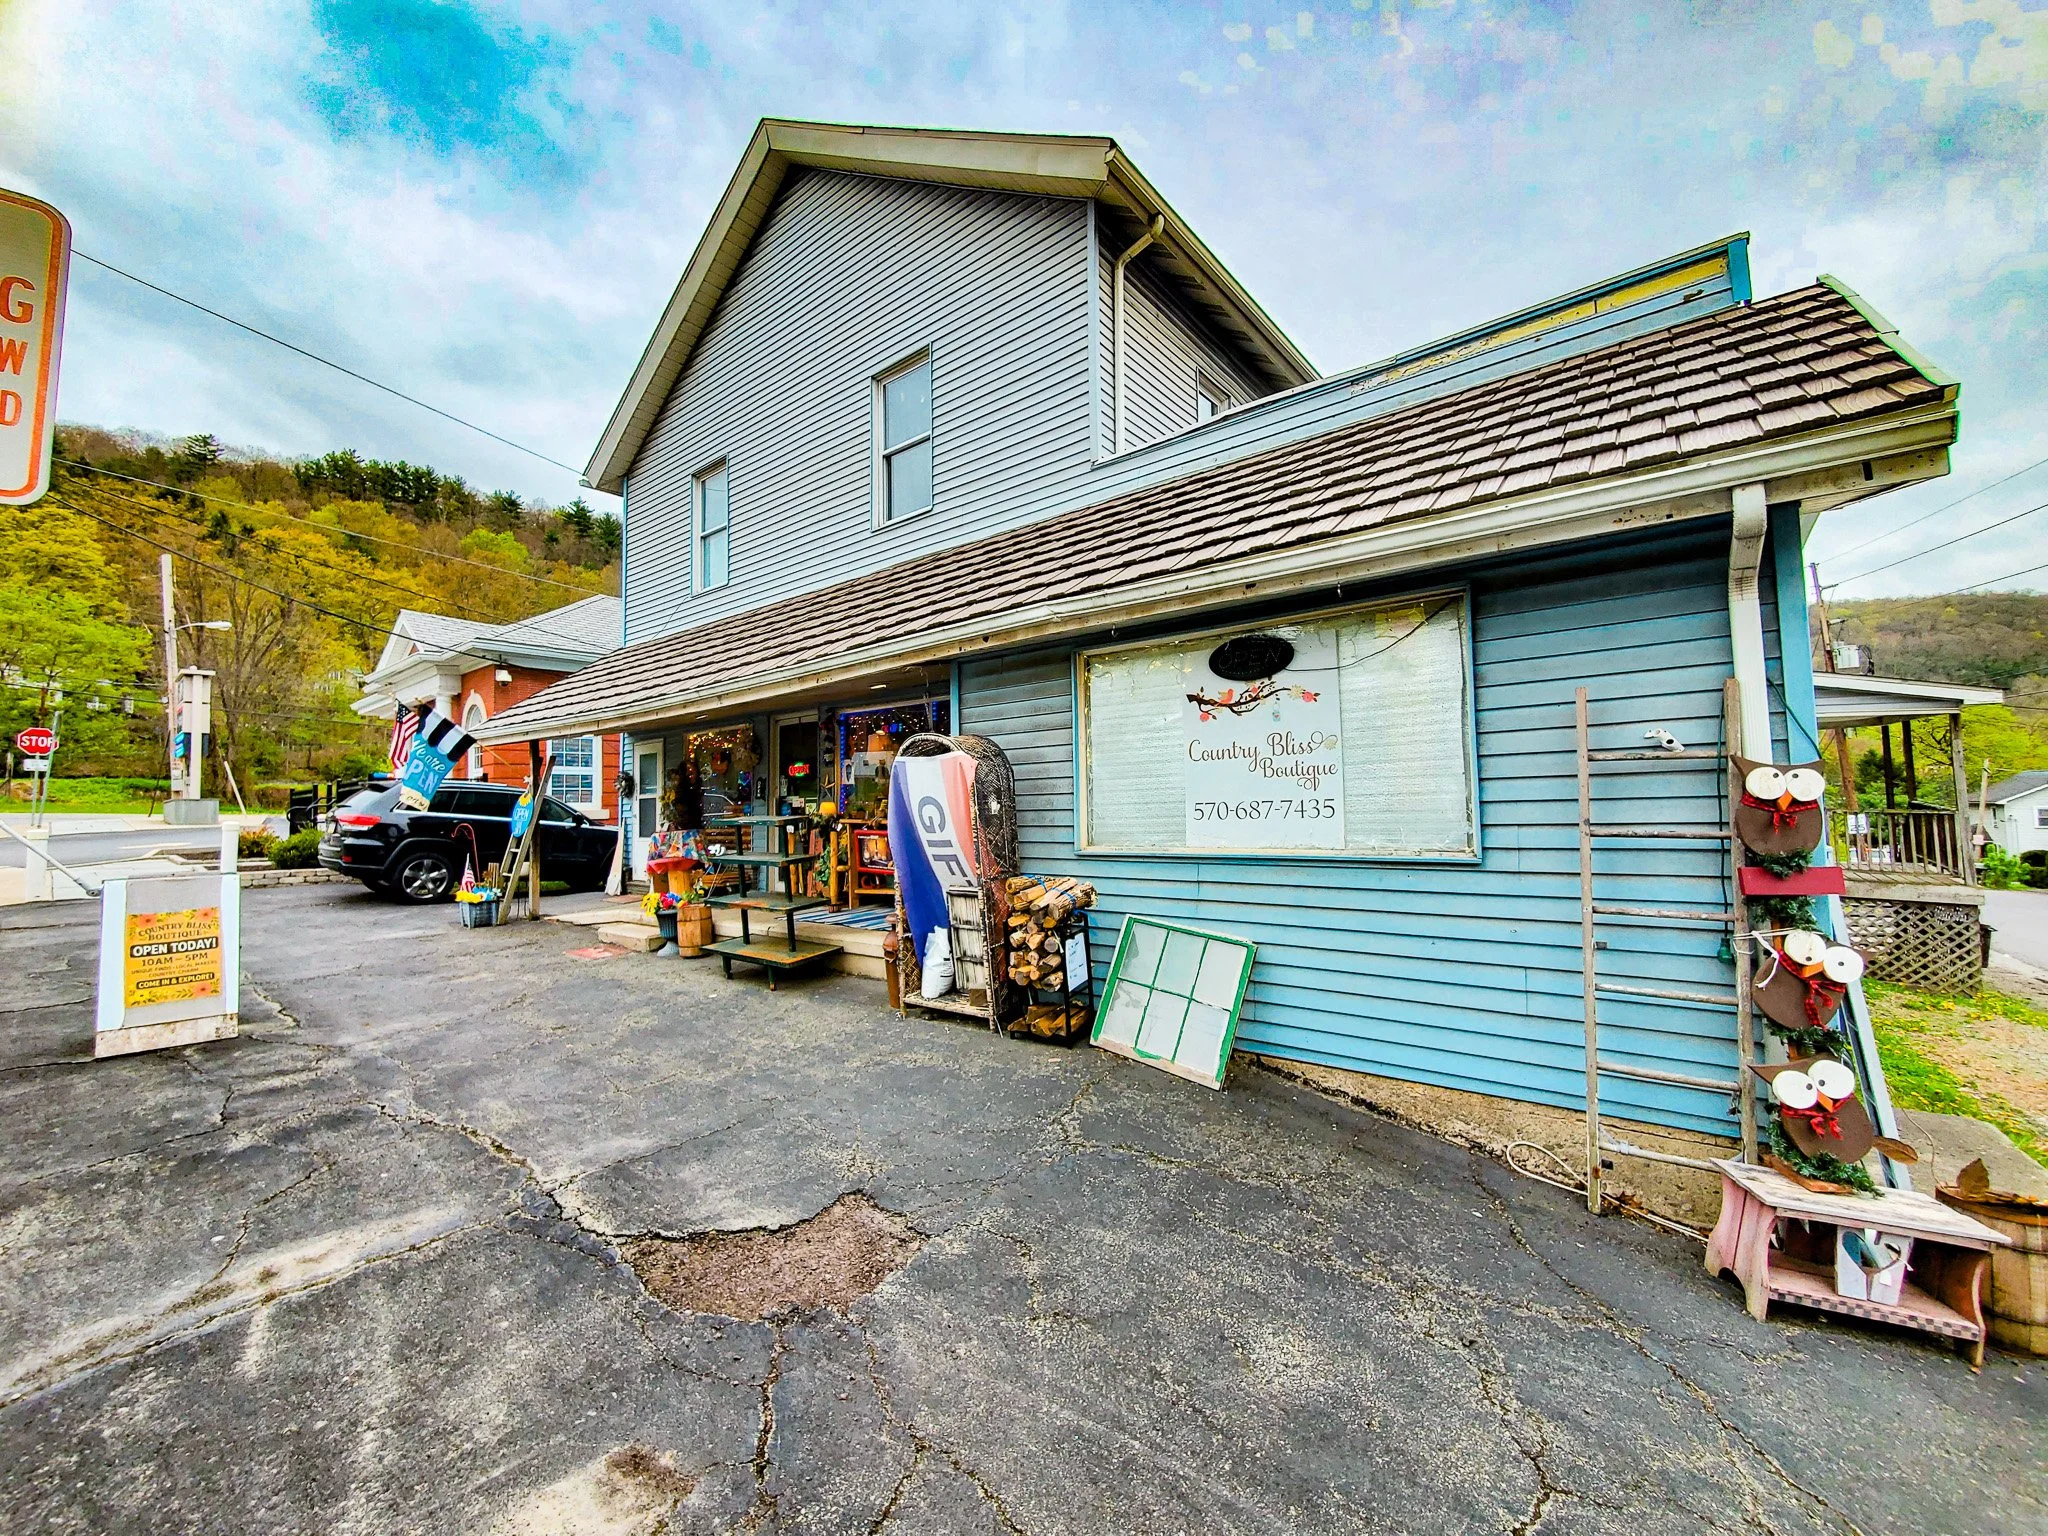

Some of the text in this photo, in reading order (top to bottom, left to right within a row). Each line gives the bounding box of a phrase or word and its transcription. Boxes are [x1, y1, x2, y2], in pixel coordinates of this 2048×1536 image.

[1188, 730, 1337, 773] Country Bliss
[424, 754, 446, 773] are
[403, 758, 439, 794] PEN
[1259, 757, 1338, 791] Boutique
[1193, 798, 1336, 820] 570-687-7435
[917, 796, 974, 888] GIF
[138, 921, 213, 937] COUNTRY BLISS
[147, 929, 202, 941] BOUTIQUE
[132, 937, 217, 957] OPEN TODAY!
[142, 956, 173, 967] 10AM
[185, 952, 209, 962] 5PM
[138, 980, 161, 989] COME
[161, 978, 170, 986] IN
[178, 973, 214, 983] EXPLORE!
